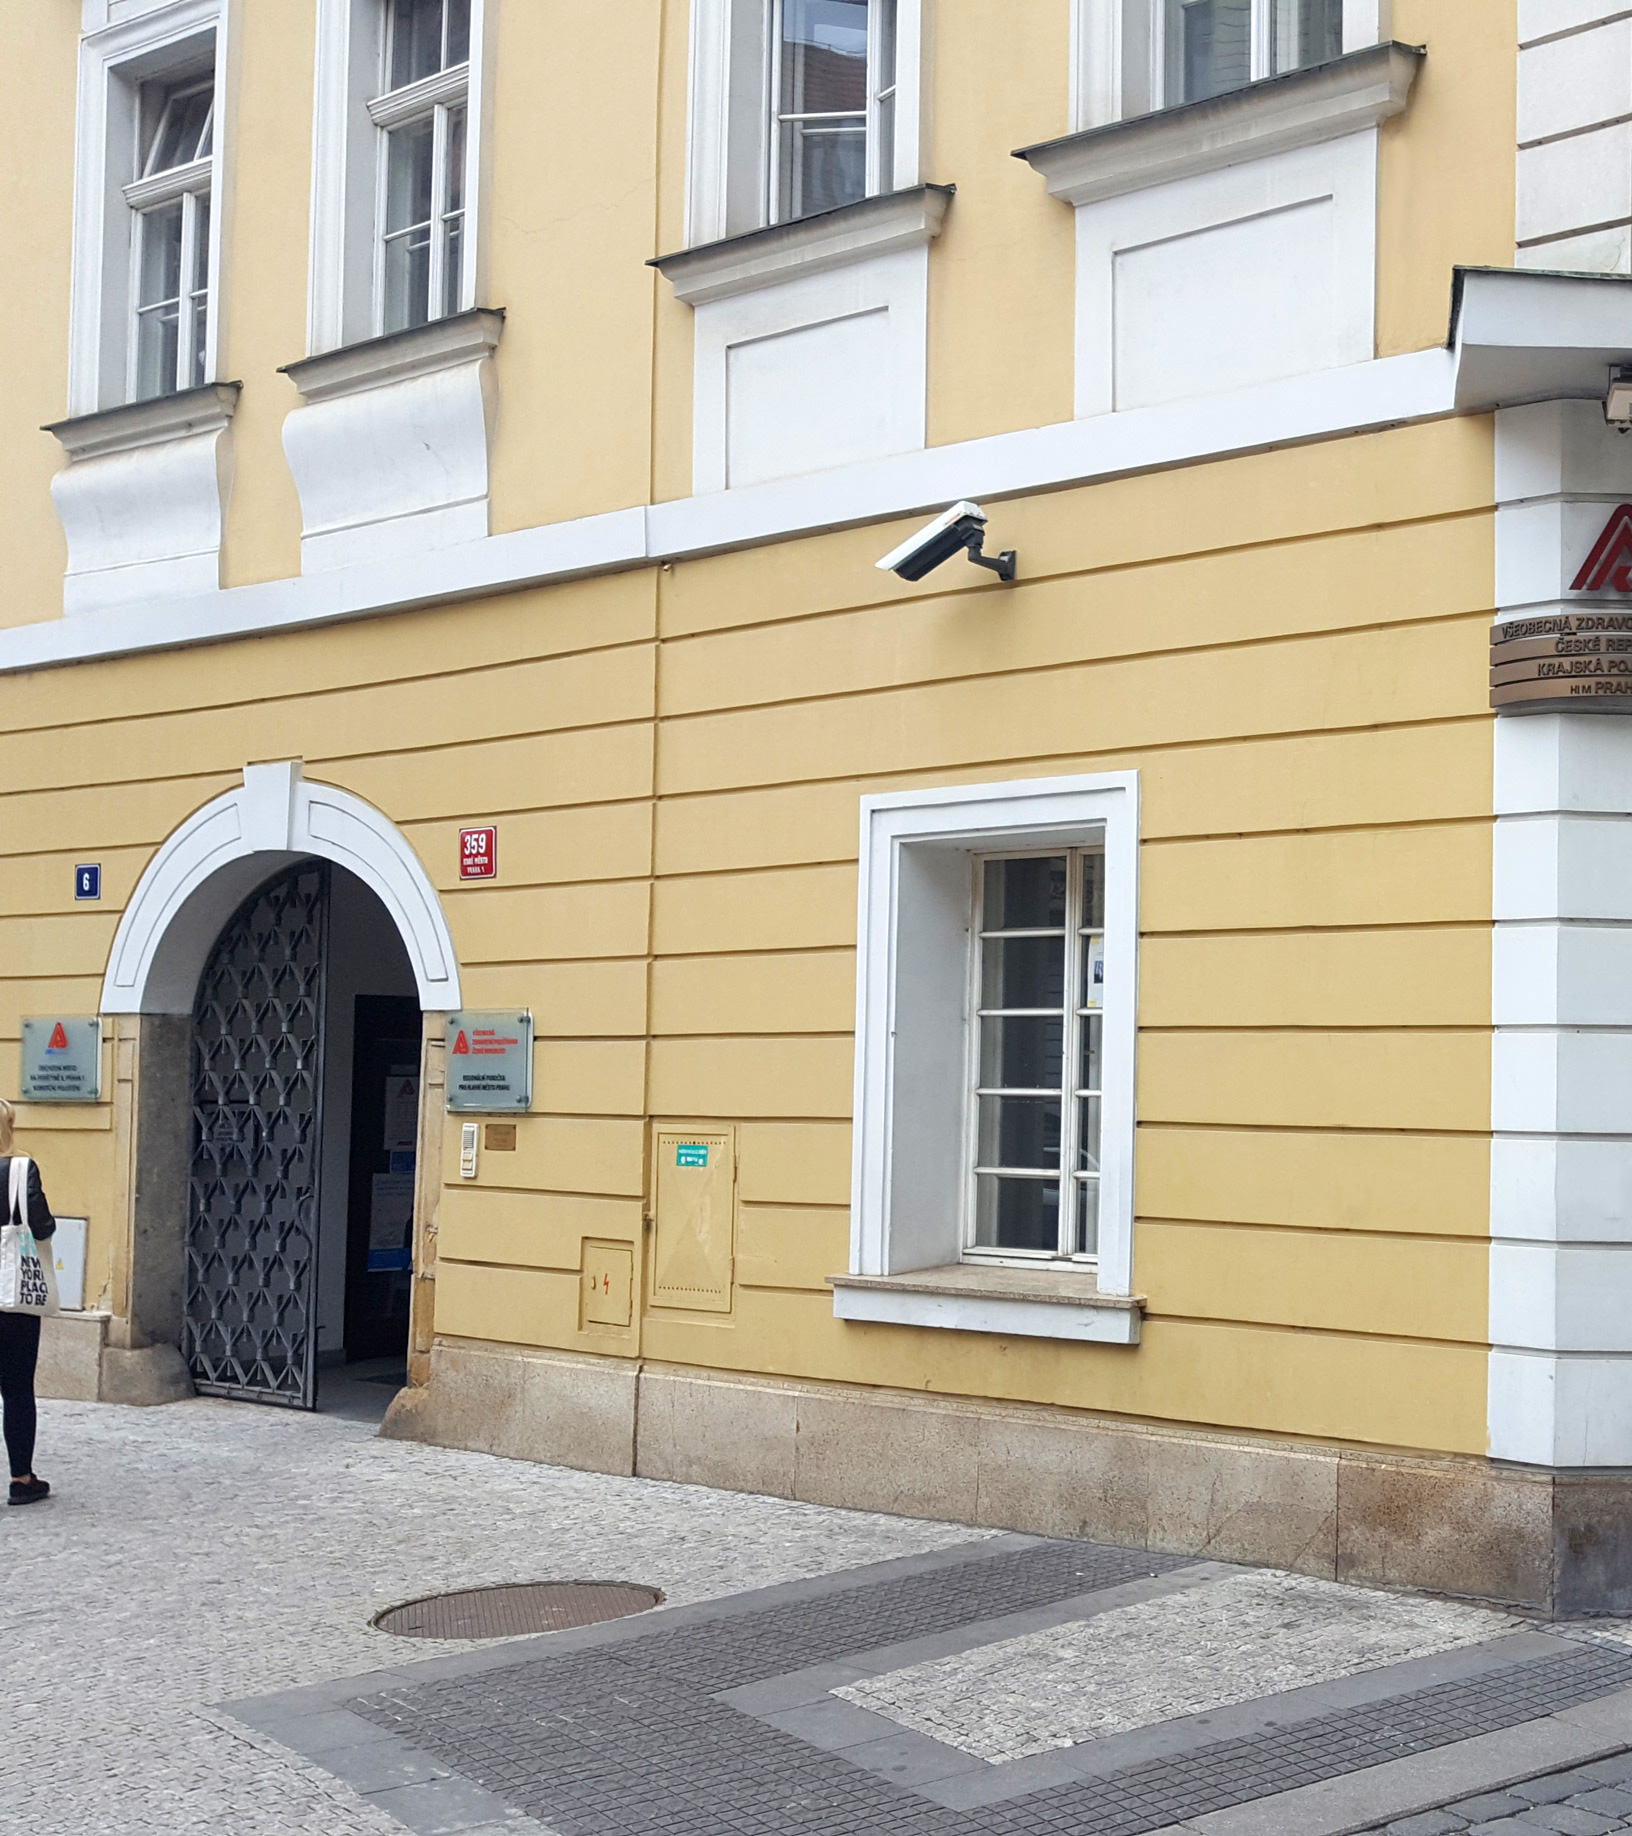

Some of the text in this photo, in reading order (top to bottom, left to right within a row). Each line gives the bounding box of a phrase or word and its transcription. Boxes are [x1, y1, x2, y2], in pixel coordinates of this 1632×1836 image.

[1502, 616, 1571, 639] VŠEOBECNÁ
[1555, 636, 1600, 653] ČESKÉ
[1537, 657, 1604, 677] KRAJSKÁ
[464, 833, 486, 855] 359
[83, 872, 90, 891] 6
[20, 1280, 48, 1294] PLAC
[20, 1293, 47, 1306] TO BE
